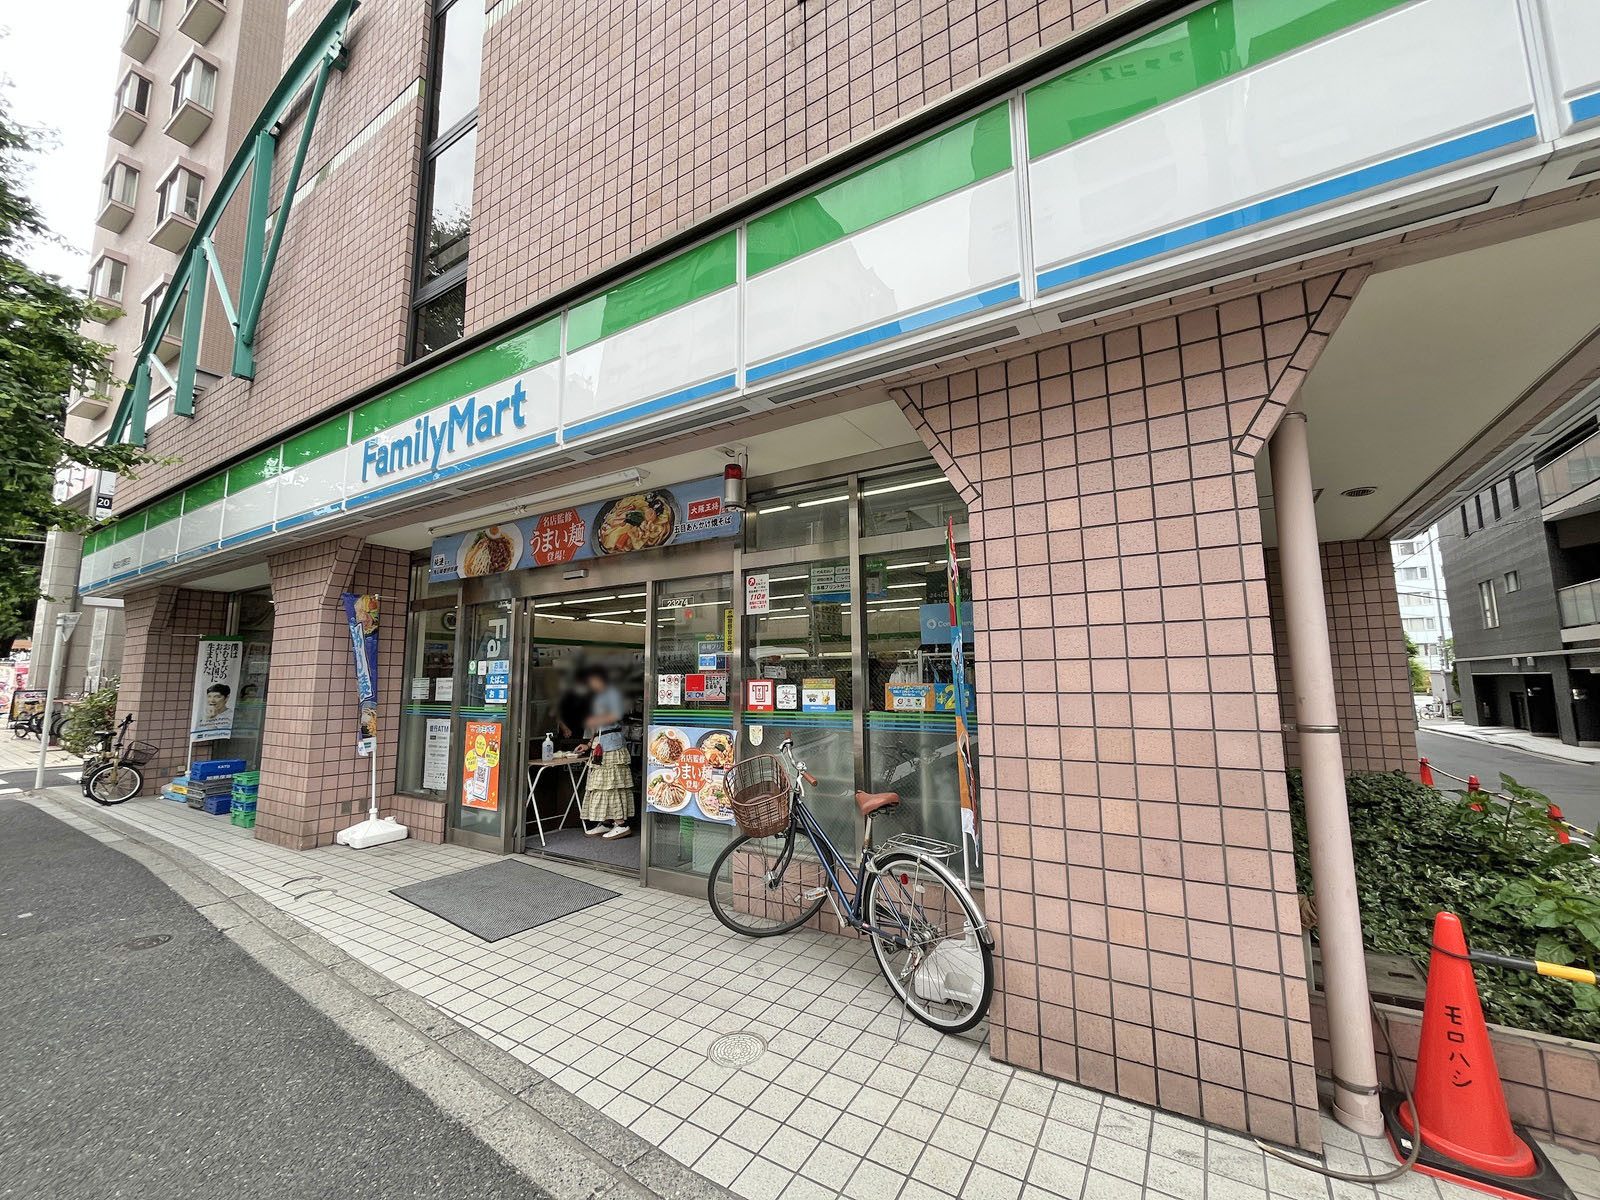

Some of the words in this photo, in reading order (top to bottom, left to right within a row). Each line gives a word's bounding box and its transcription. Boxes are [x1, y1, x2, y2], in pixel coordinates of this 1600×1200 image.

[362, 379, 528, 484] FamilyMart
[97, 497, 110, 507] 20
[690, 501, 720, 515] 大阪王将
[543, 511, 573, 527] 名店監修
[674, 515, 733, 534] 五目あんかけ焼そば
[530, 520, 586, 556] うまい麺
[487, 618, 507, 658] Fa
[218, 643, 231, 680] おむすびの
[230, 643, 240, 659] 僕は
[210, 643, 223, 683] おいしい国に
[489, 675, 505, 684] たばこ
[672, 763, 714, 784] うまい麺
[1443, 1004, 1473, 1088] モロハシ
